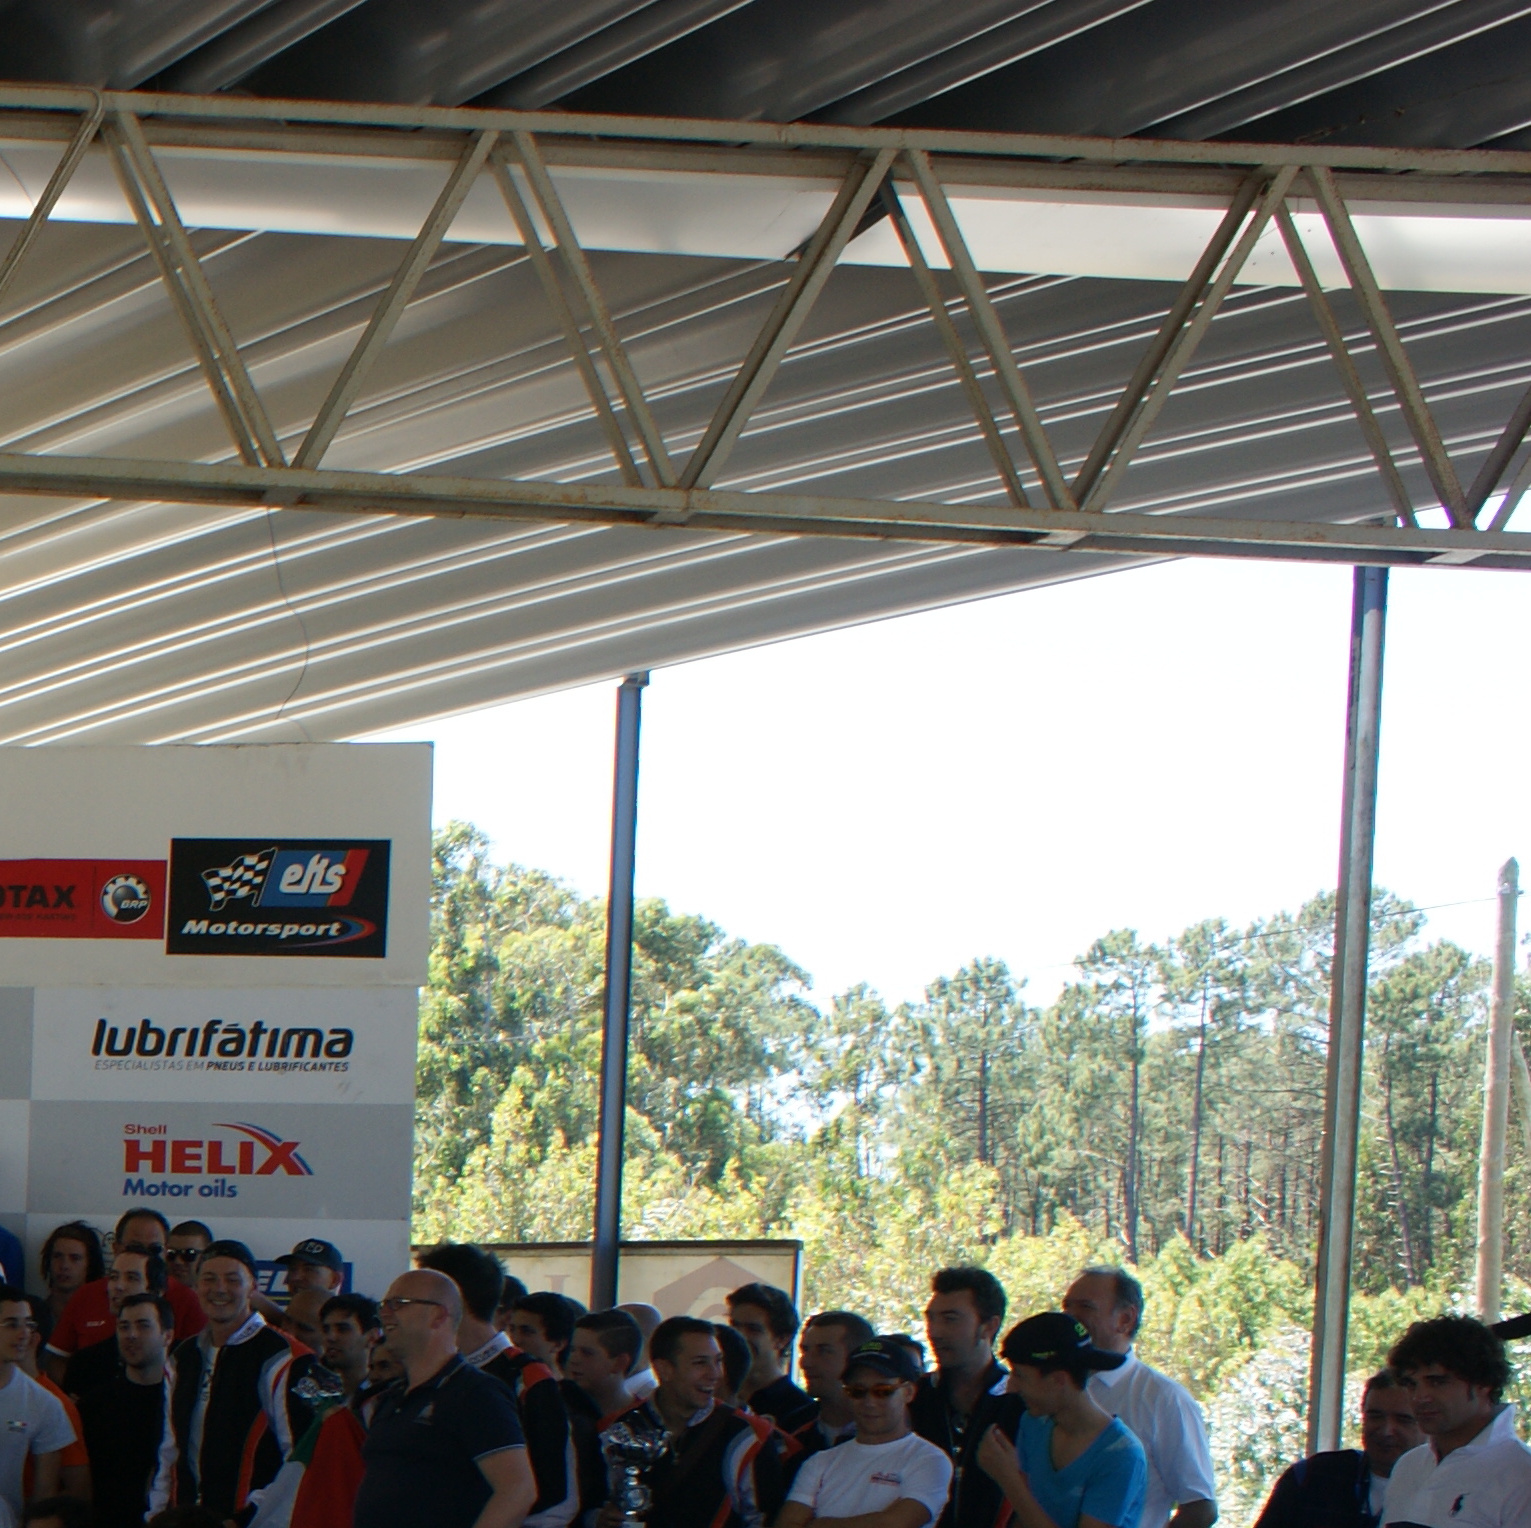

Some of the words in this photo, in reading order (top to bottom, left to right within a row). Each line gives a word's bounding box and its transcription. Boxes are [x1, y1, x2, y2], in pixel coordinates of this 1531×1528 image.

[119, 899, 149, 909] BRP
[181, 919, 342, 940] Motorsport
[94, 1059, 184, 1072] ESPECIALISTAS
[185, 1060, 205, 1072] EM
[206, 1060, 245, 1072] PNEUS
[247, 1061, 255, 1072] E
[257, 1061, 350, 1073] LUBRIFICANTES
[123, 1123, 167, 1135] Shell
[123, 1134, 309, 1177] HELIX
[121, 1177, 193, 1198] Motor
[198, 1177, 238, 1198] oils
